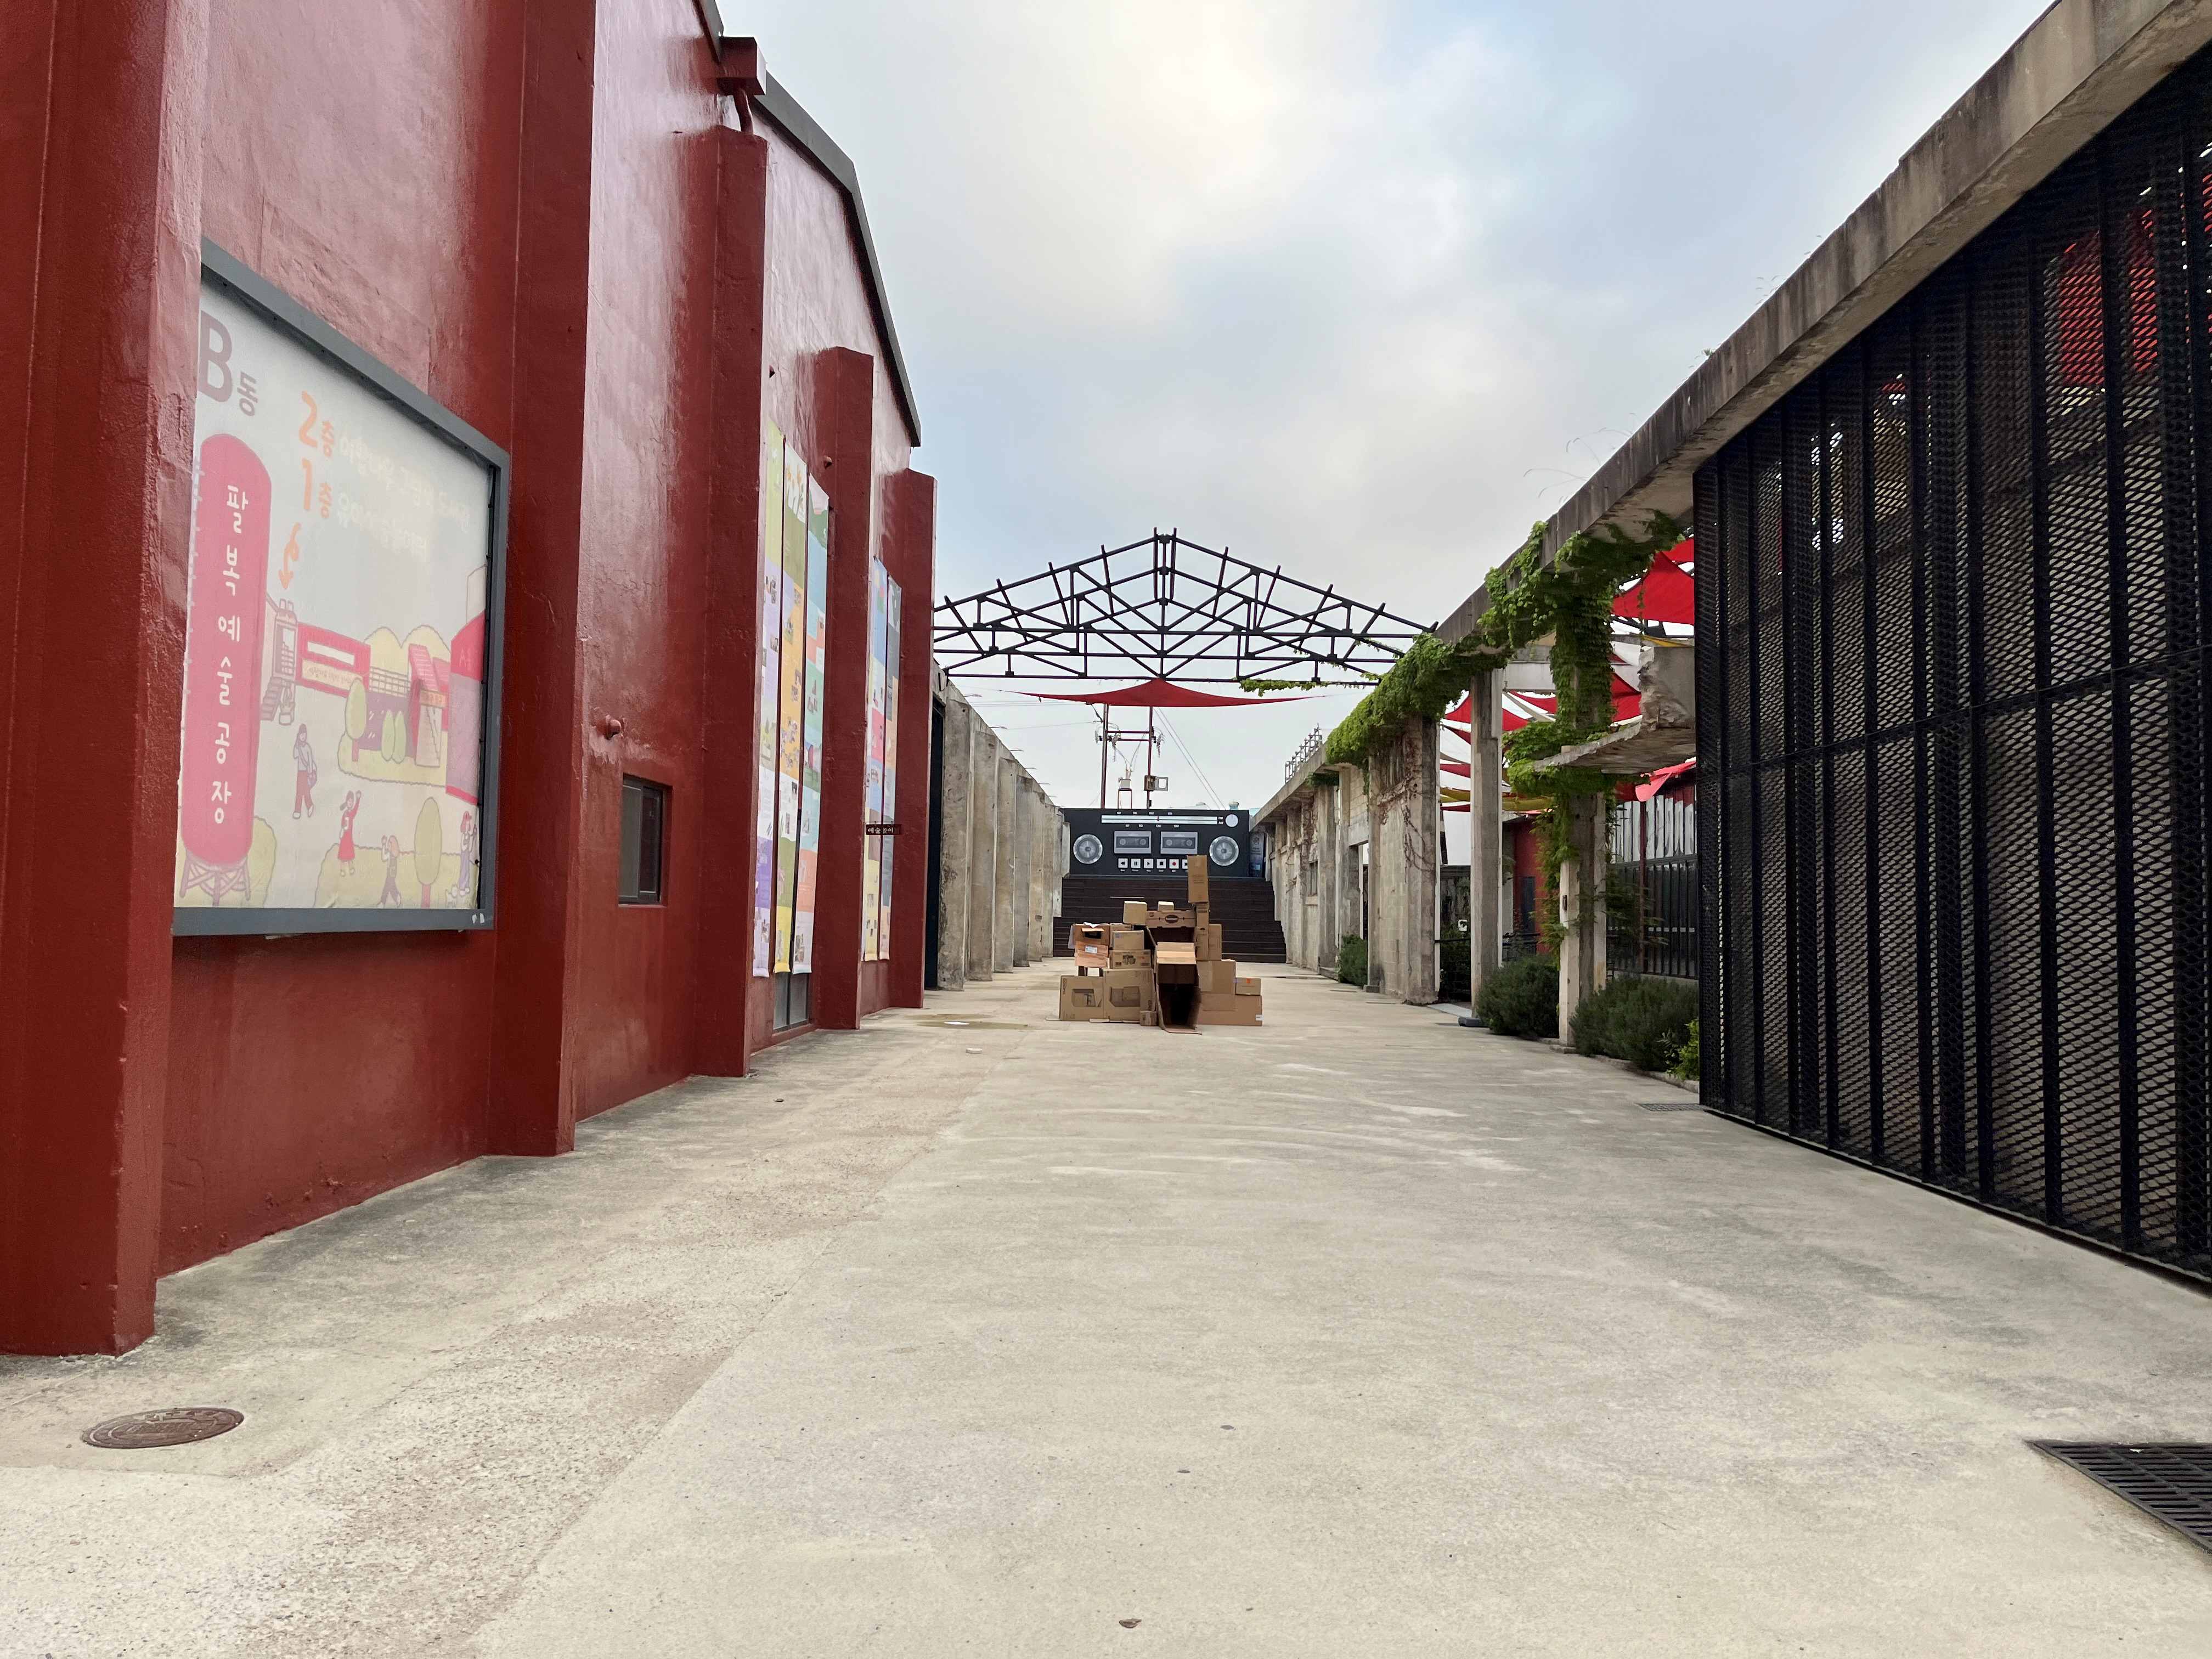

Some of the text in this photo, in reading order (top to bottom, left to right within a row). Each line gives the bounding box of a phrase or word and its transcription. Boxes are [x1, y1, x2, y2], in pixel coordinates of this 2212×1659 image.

[198, 310, 258, 416] B동
[299, 390, 334, 458] 2층
[302, 458, 332, 518] 1층
